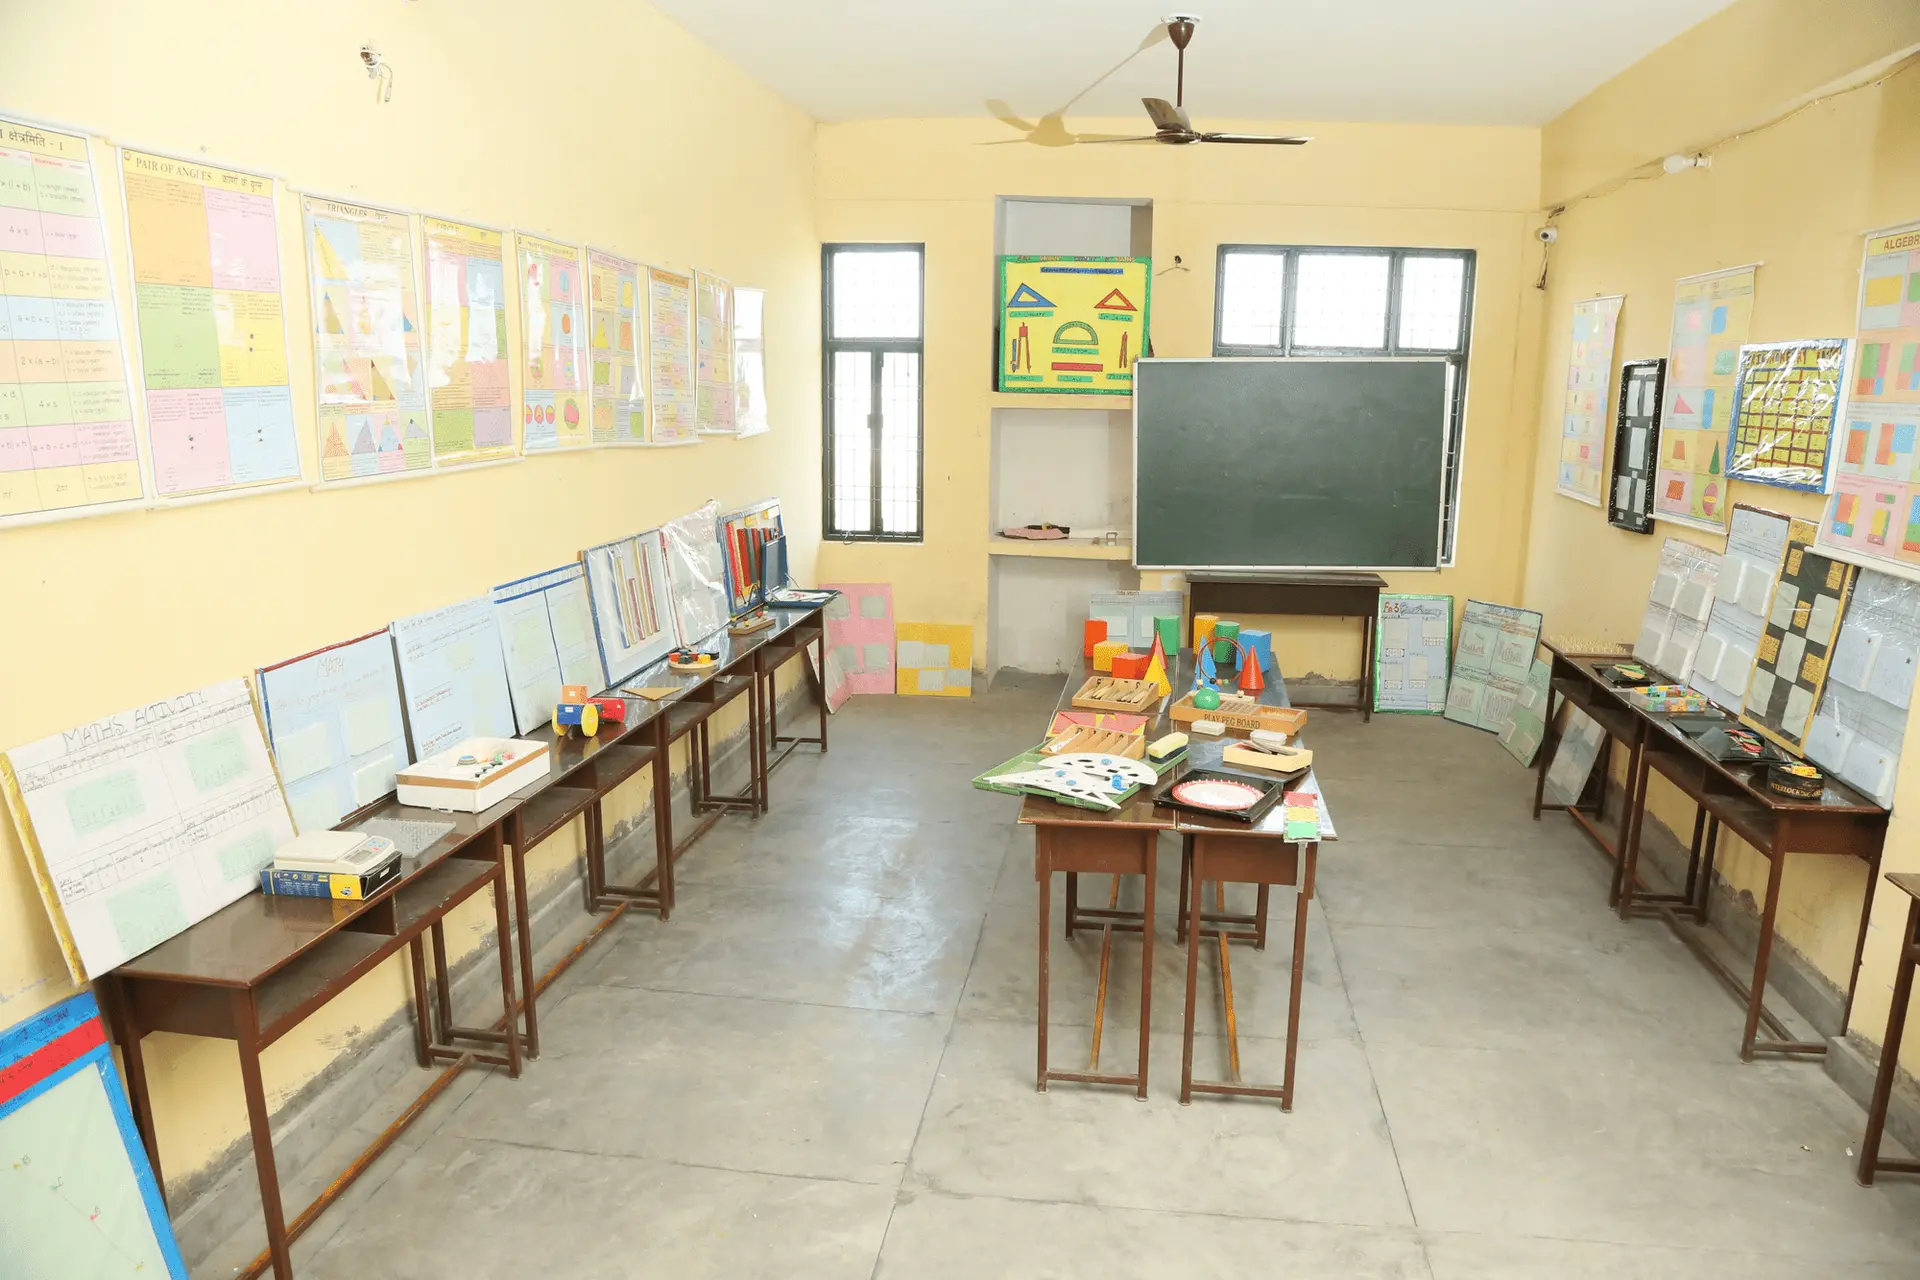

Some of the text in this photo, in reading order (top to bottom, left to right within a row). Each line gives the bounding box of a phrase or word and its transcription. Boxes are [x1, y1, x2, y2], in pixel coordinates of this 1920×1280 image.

[135, 157, 212, 181] PAIR OF ANGLES
[326, 203, 368, 217] TRIANGLES
[62, 689, 208, 751] MATHS ACTIVITY
[1204, 713, 1260, 729] PLAY PEG BOARD
